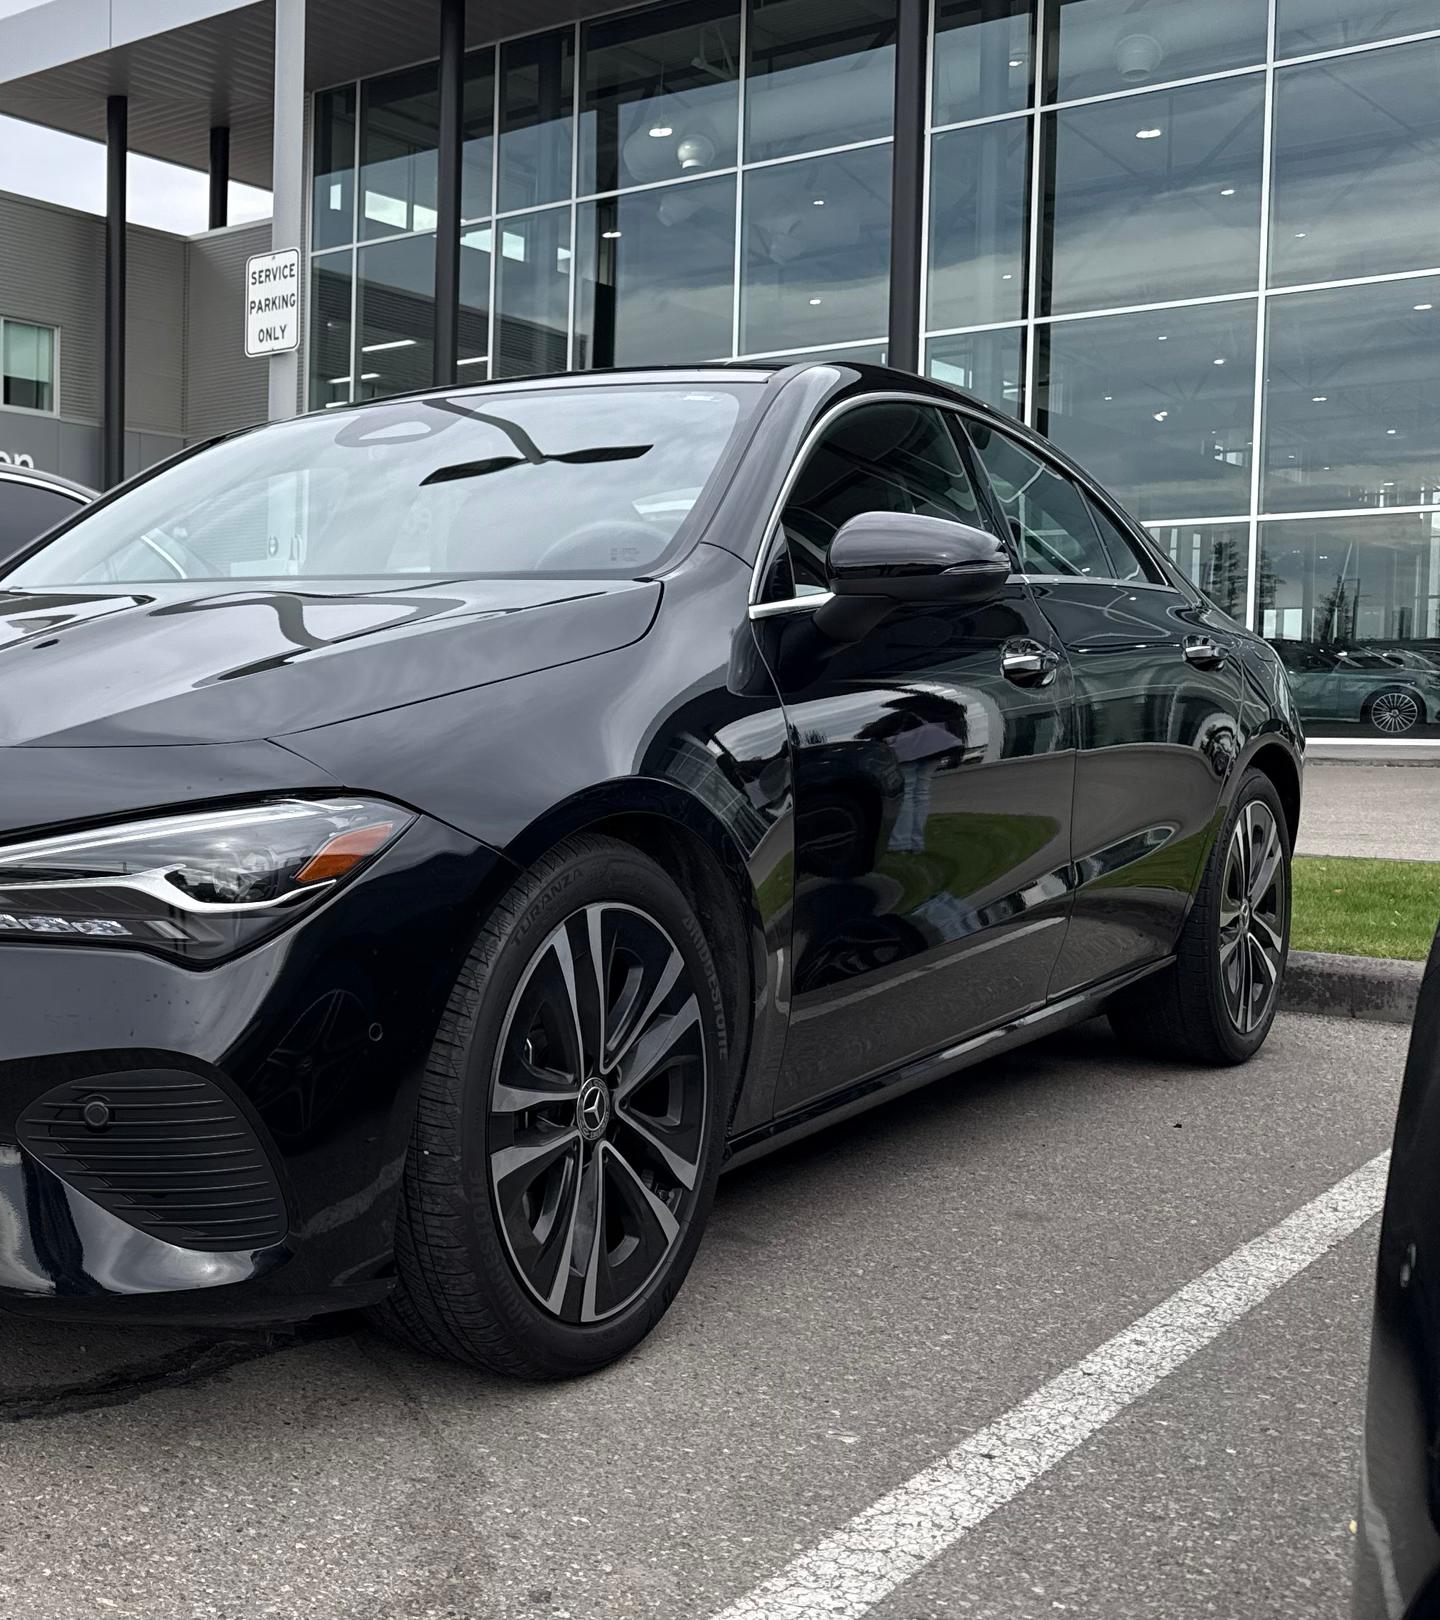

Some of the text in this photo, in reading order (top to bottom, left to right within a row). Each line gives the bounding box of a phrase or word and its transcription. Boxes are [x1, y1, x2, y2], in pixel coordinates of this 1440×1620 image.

[251, 262, 296, 285] SERVICE
[249, 293, 296, 315] PARKING
[258, 324, 287, 343] ONLY
[509, 867, 586, 947] TURANZA
